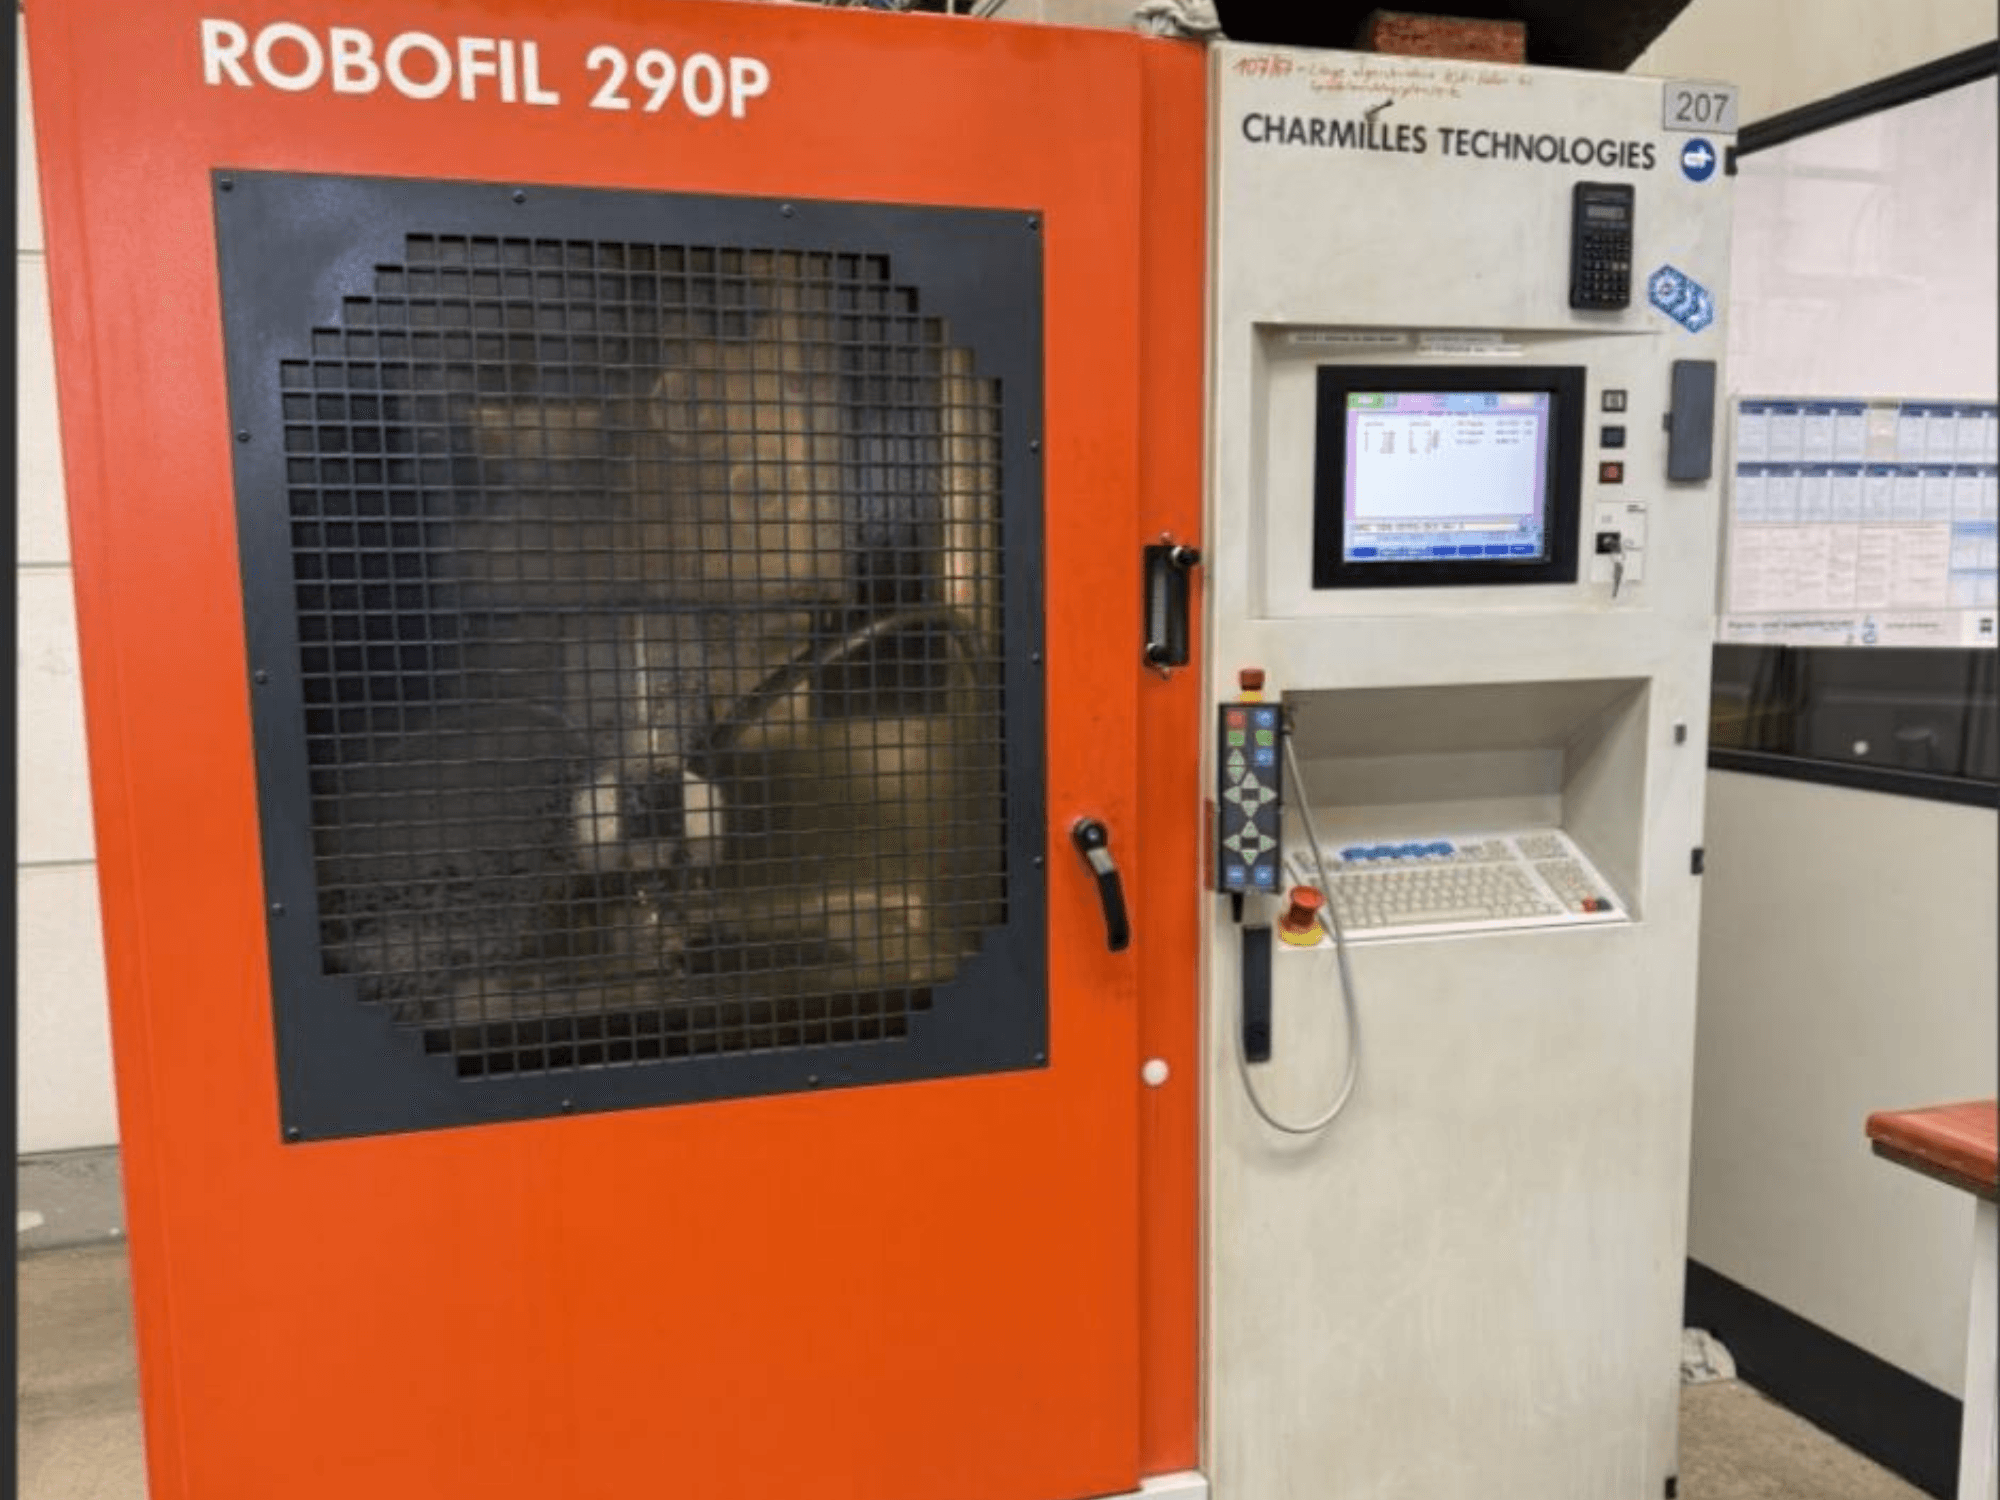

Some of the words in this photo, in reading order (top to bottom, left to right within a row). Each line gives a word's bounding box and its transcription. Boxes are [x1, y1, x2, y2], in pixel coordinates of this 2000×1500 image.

[202, 18, 560, 105] ROBOFIL
[586, 45, 770, 118] 290P
[1676, 91, 1729, 123] 207
[1242, 112, 1428, 155] CHARMILLES
[1437, 127, 1656, 171] TECHNOLOGIES
